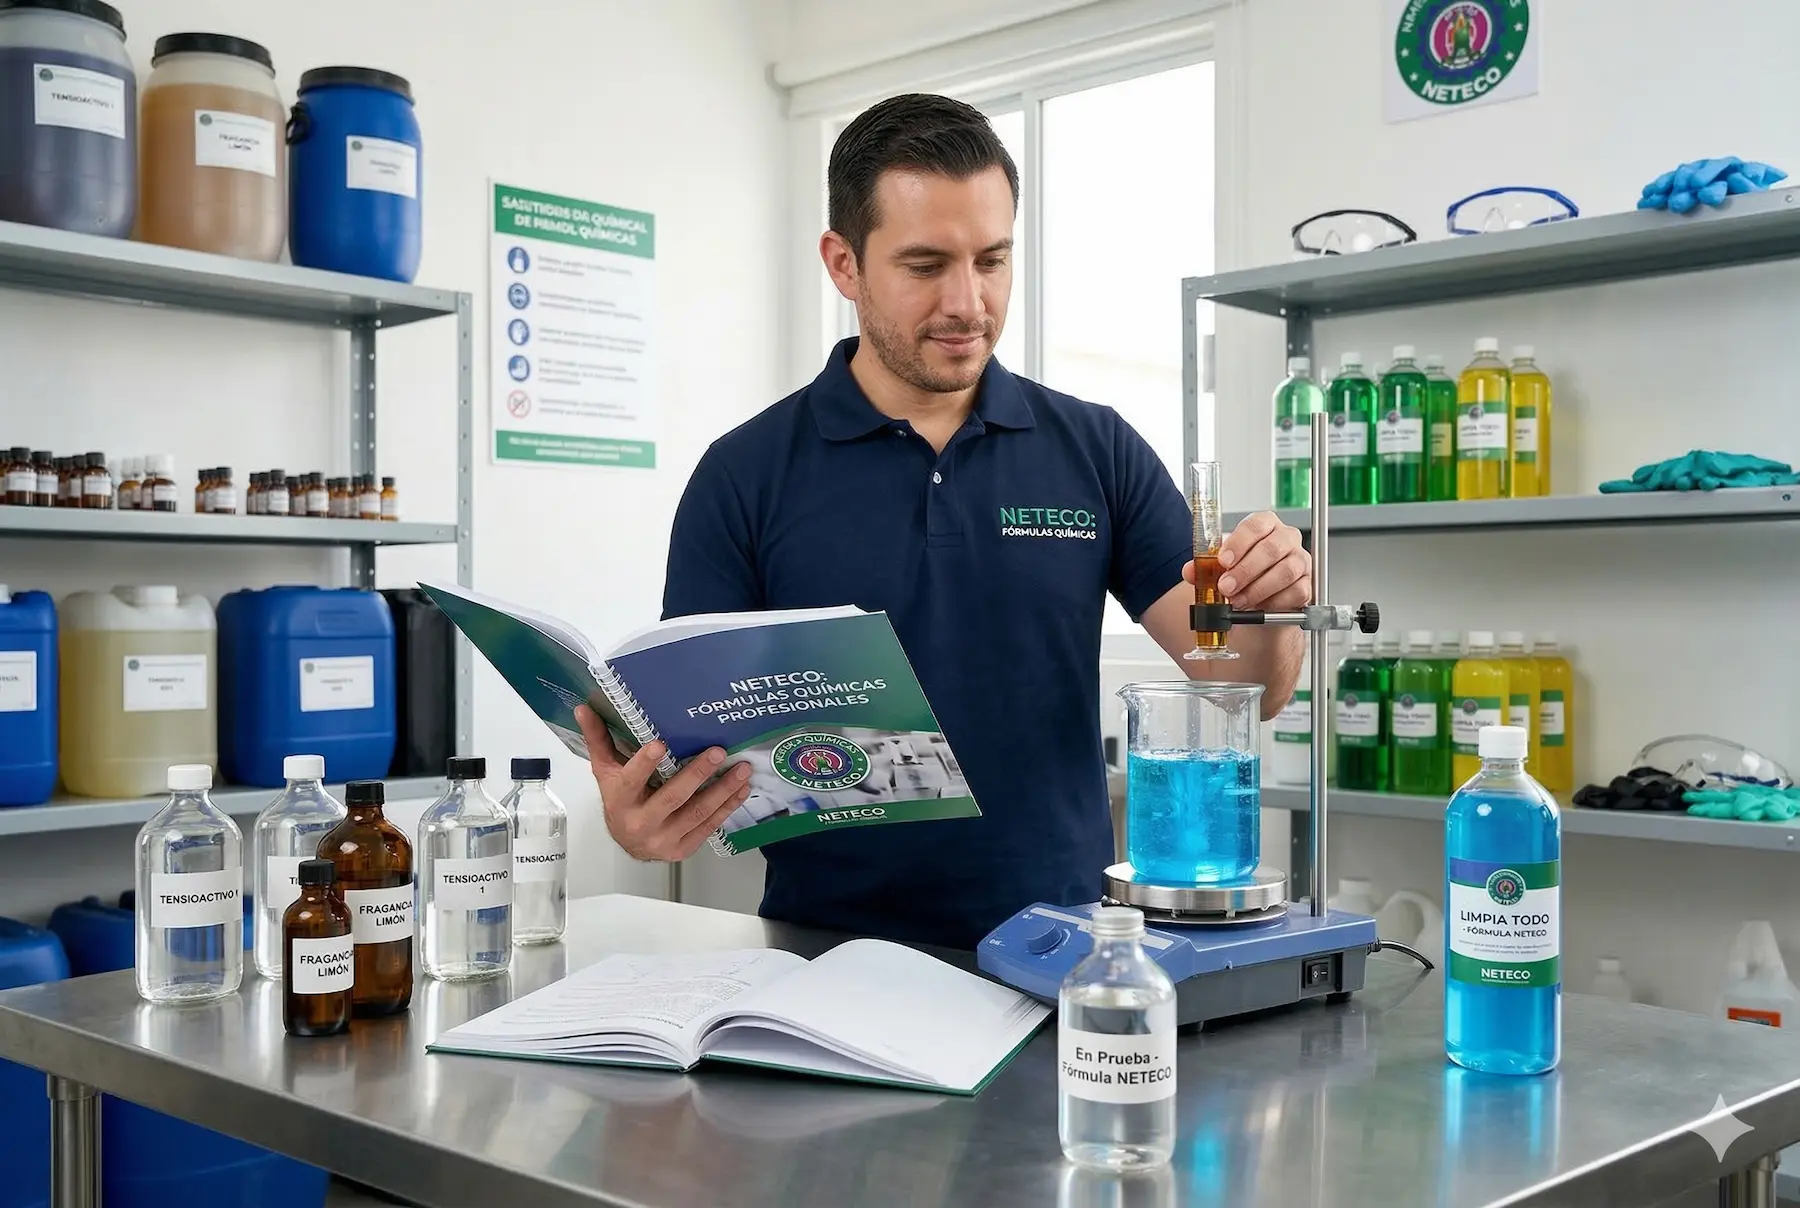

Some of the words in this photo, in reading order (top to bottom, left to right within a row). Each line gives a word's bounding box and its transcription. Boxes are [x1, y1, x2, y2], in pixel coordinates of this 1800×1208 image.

[1421, 66, 1502, 102] NETECO
[1000, 507, 1096, 528] NETECO:
[1002, 525, 1053, 537] FÓRMULAS
[1054, 527, 1097, 539] QUÍMICAS
[730, 670, 828, 694] NETECO:
[687, 689, 789, 718] FÓRMULAS
[793, 678, 887, 698] QUÍMICAS
[717, 694, 870, 724] PROFESIONALES
[801, 772, 862, 789] NETECO
[817, 807, 886, 822] NETECO
[443, 870, 508, 884] TENSIOACTIVO
[160, 891, 234, 904] TENSIOACTIVO
[376, 912, 405, 927] LIMÓN
[1460, 910, 1508, 925] LIMPIA
[1511, 914, 1549, 926] TODO
[1467, 926, 1511, 937] FÓRMULA
[1514, 929, 1547, 937] NETECO
[318, 960, 349, 977] LIMÓN
[1481, 968, 1530, 980] NETECO
[1076, 1047, 1092, 1061] En
[1098, 1051, 1150, 1065] Prueba
[1062, 1061, 1112, 1084] Fórmula
[1117, 1066, 1171, 1084] NETECO
